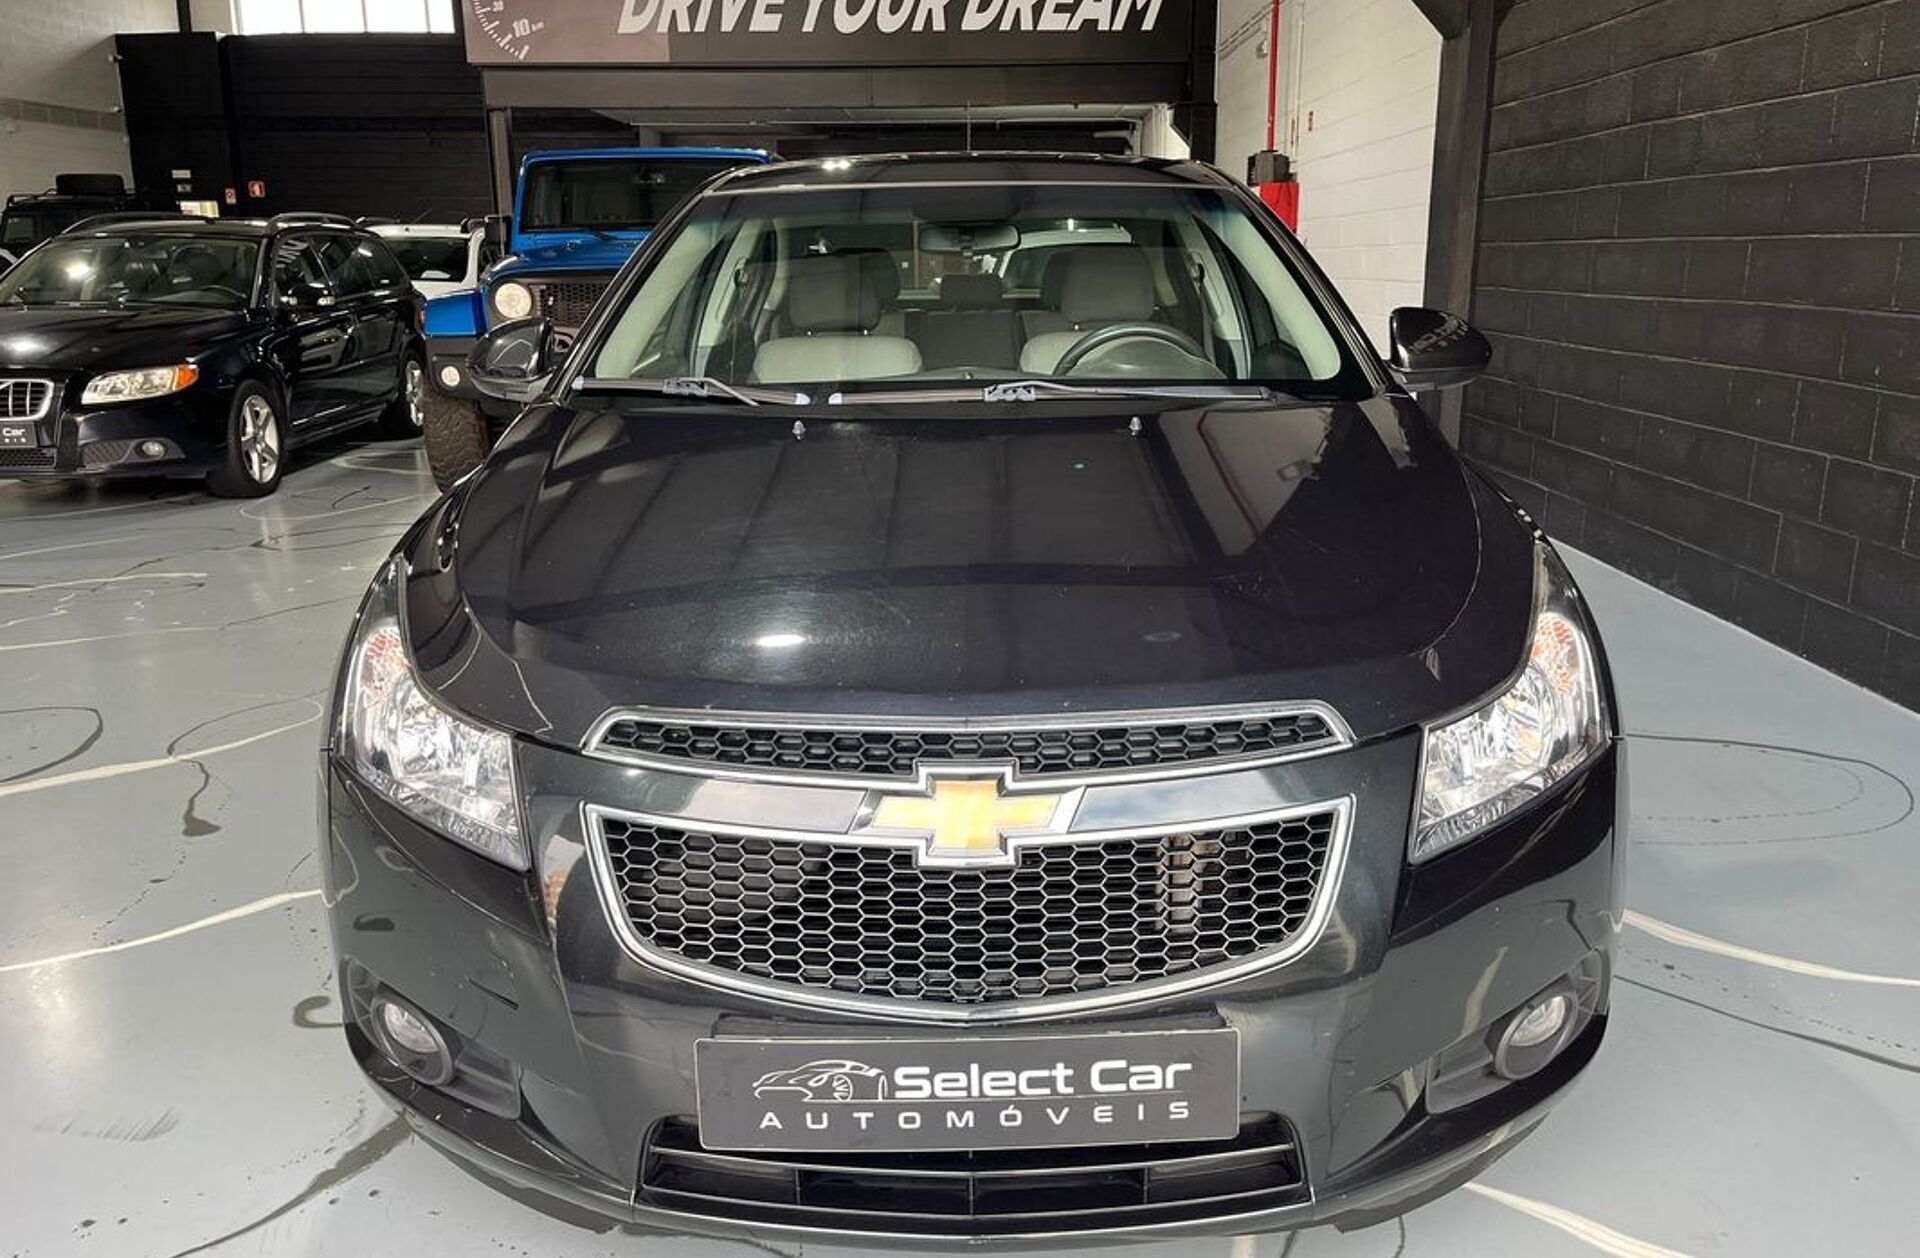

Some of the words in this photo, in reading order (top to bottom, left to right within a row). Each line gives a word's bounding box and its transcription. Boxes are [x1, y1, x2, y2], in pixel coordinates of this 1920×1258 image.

[512, 18, 530, 37] 10
[617, 0, 784, 34] DRIVE
[802, 0, 946, 33] YOUR
[961, 0, 1162, 31] DREAM
[894, 1063, 1074, 1098] Select
[1090, 1060, 1192, 1092] Car
[759, 1101, 1189, 1130] AUTOMÓVEIS
